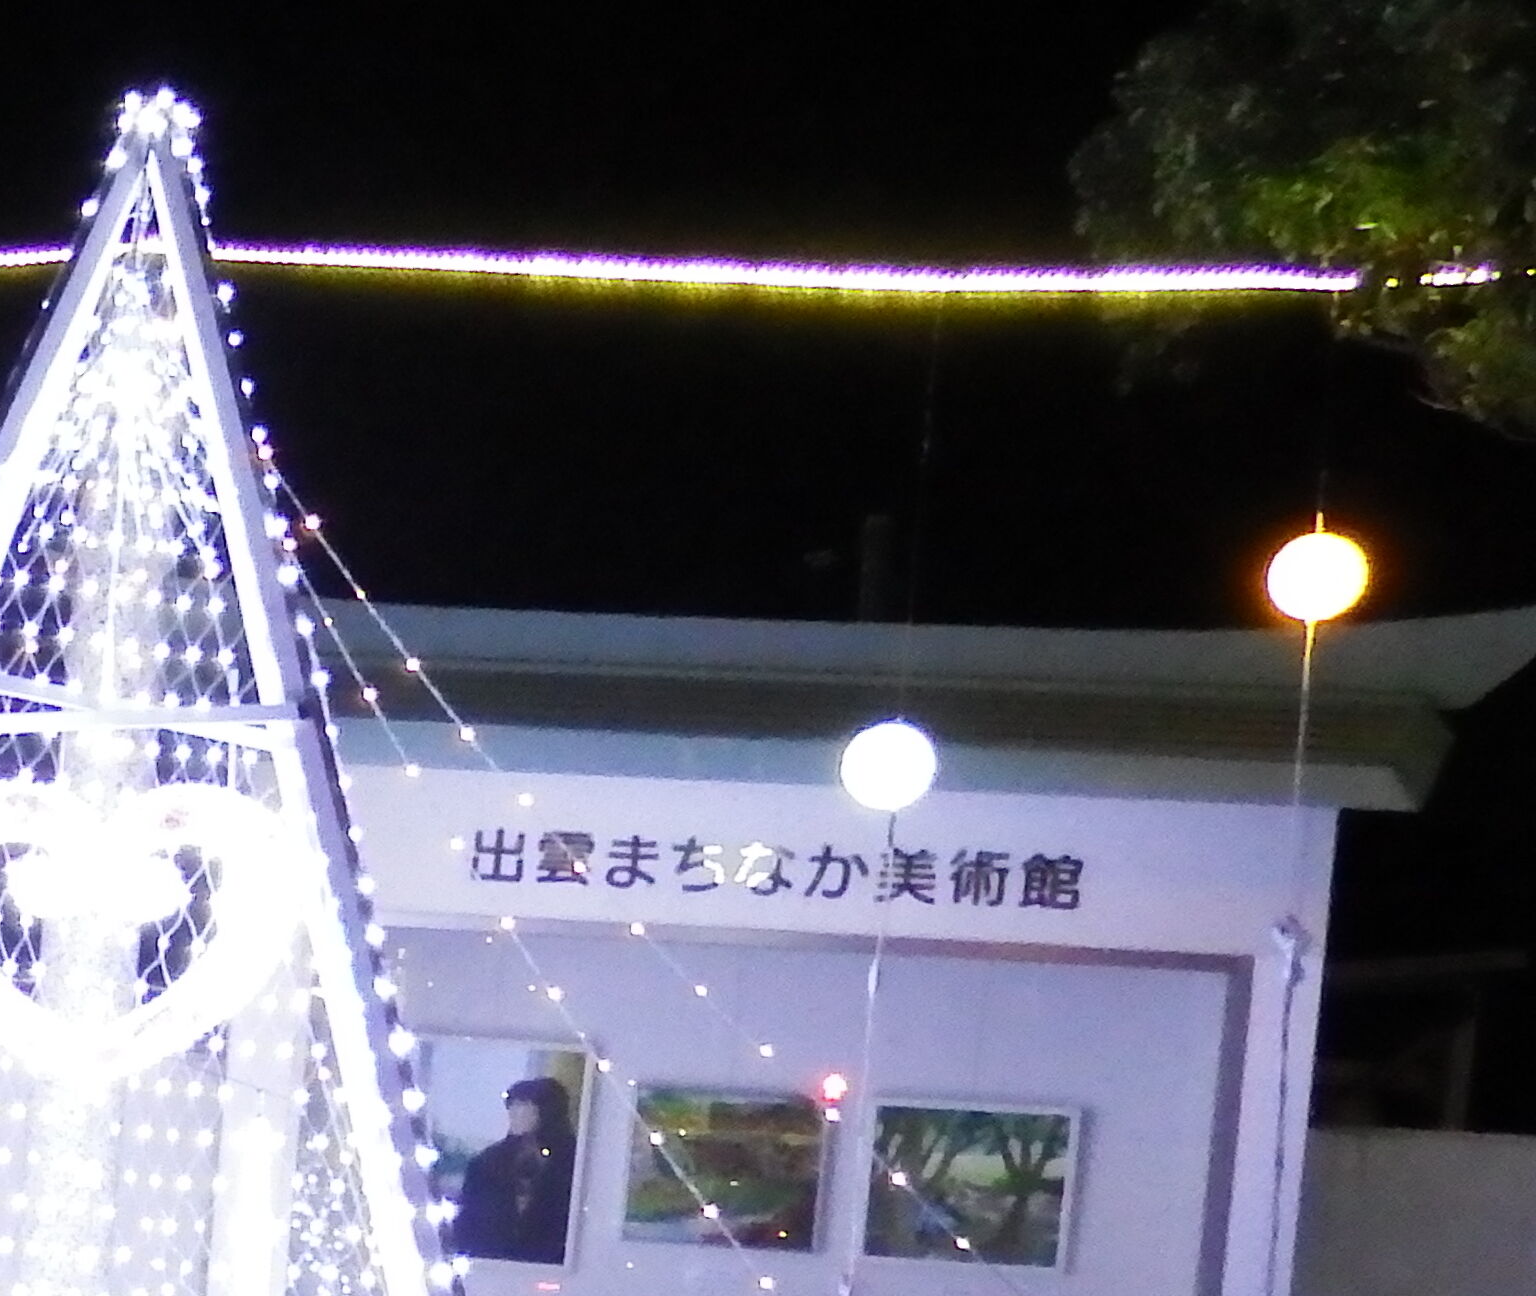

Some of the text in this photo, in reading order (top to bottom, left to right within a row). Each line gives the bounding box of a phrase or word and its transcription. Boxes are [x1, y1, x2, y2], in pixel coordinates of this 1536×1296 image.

[471, 827, 1085, 911] 出雲まちなか美術館
